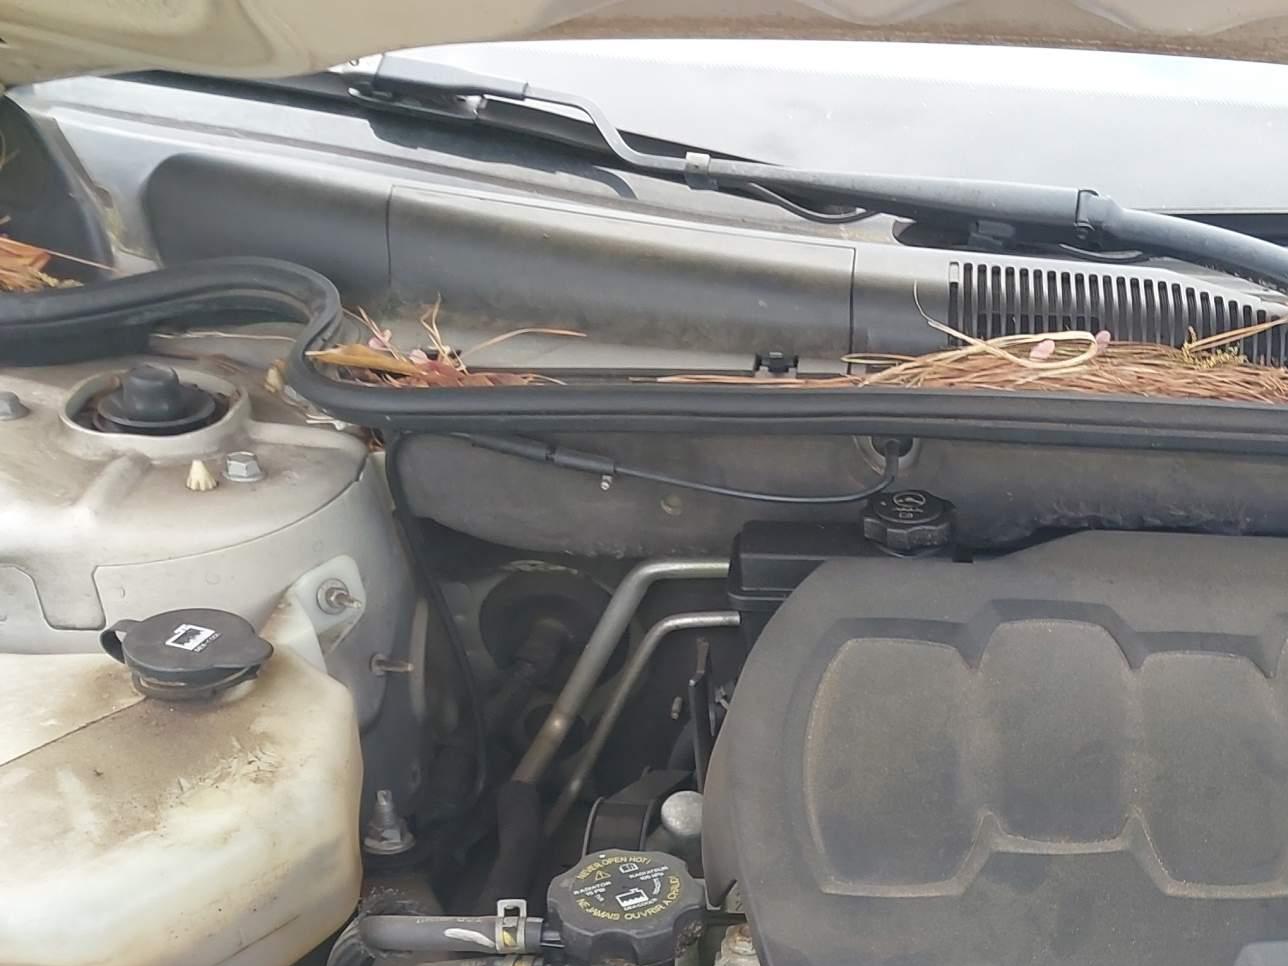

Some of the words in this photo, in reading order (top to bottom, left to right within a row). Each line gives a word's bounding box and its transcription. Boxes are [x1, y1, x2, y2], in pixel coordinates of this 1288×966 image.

[577, 862, 603, 880] NEVER
[602, 857, 627, 866] OPEN
[628, 855, 652, 865] HOT!
[573, 881, 612, 895] RADIATOR
[576, 898, 590, 909] NE
[586, 908, 620, 920] JAMAIS
[624, 904, 665, 920] OUVRIR
